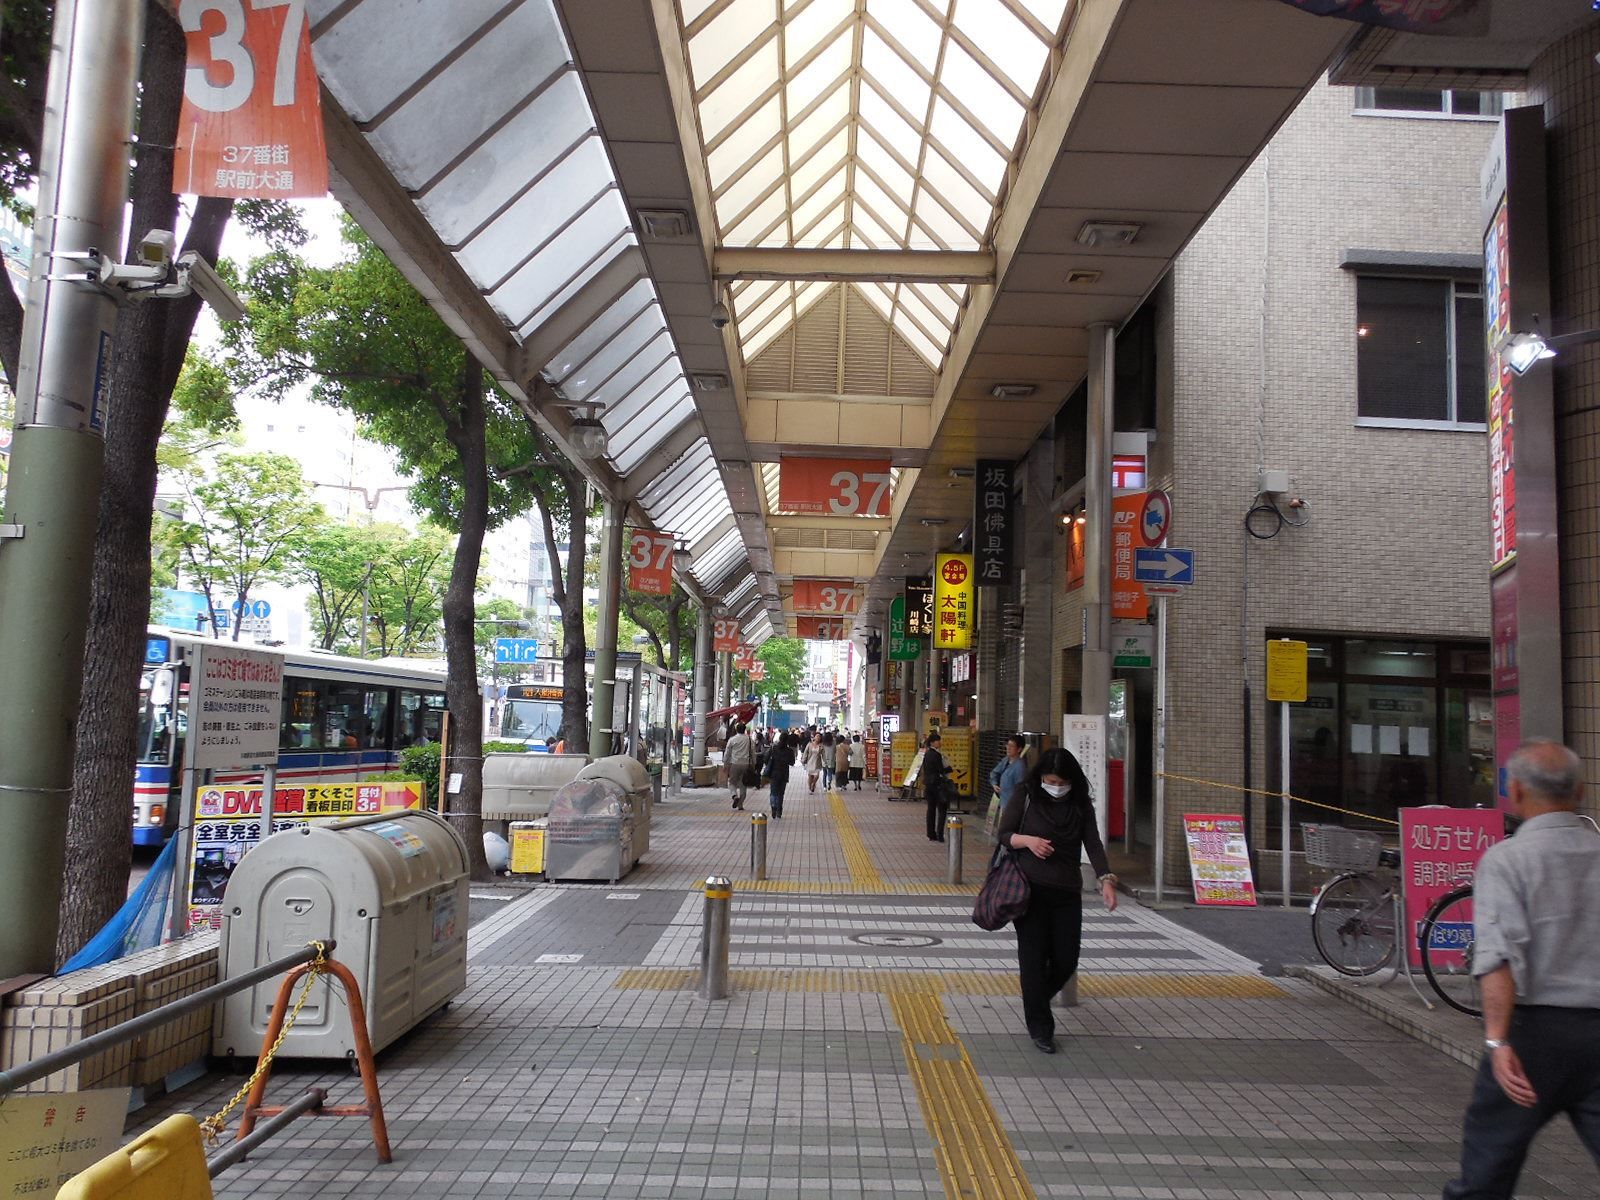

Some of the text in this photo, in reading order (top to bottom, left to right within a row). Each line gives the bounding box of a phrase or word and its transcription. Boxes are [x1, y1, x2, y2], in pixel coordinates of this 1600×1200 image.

[178, 0, 306, 112] 37
[222, 143, 290, 166] 37番街
[214, 169, 296, 192] 駅前大通
[829, 471, 891, 516] 37
[982, 467, 1010, 580] 坂田佛具店
[629, 534, 674, 570] 37
[820, 587, 854, 612] 37
[957, 592, 967, 630] 中国料理
[714, 620, 739, 639] 37
[909, 611, 919, 634] 川崎店
[940, 595, 957, 643] 太陽軒
[818, 622, 843, 640] 37
[736, 646, 754, 660] 37
[307, 787, 354, 799] すぐそこ
[359, 786, 380, 798] 受付
[306, 799, 354, 813] 看板目印
[357, 798, 378, 812] 3F
[1411, 824, 1496, 851] 処方せん
